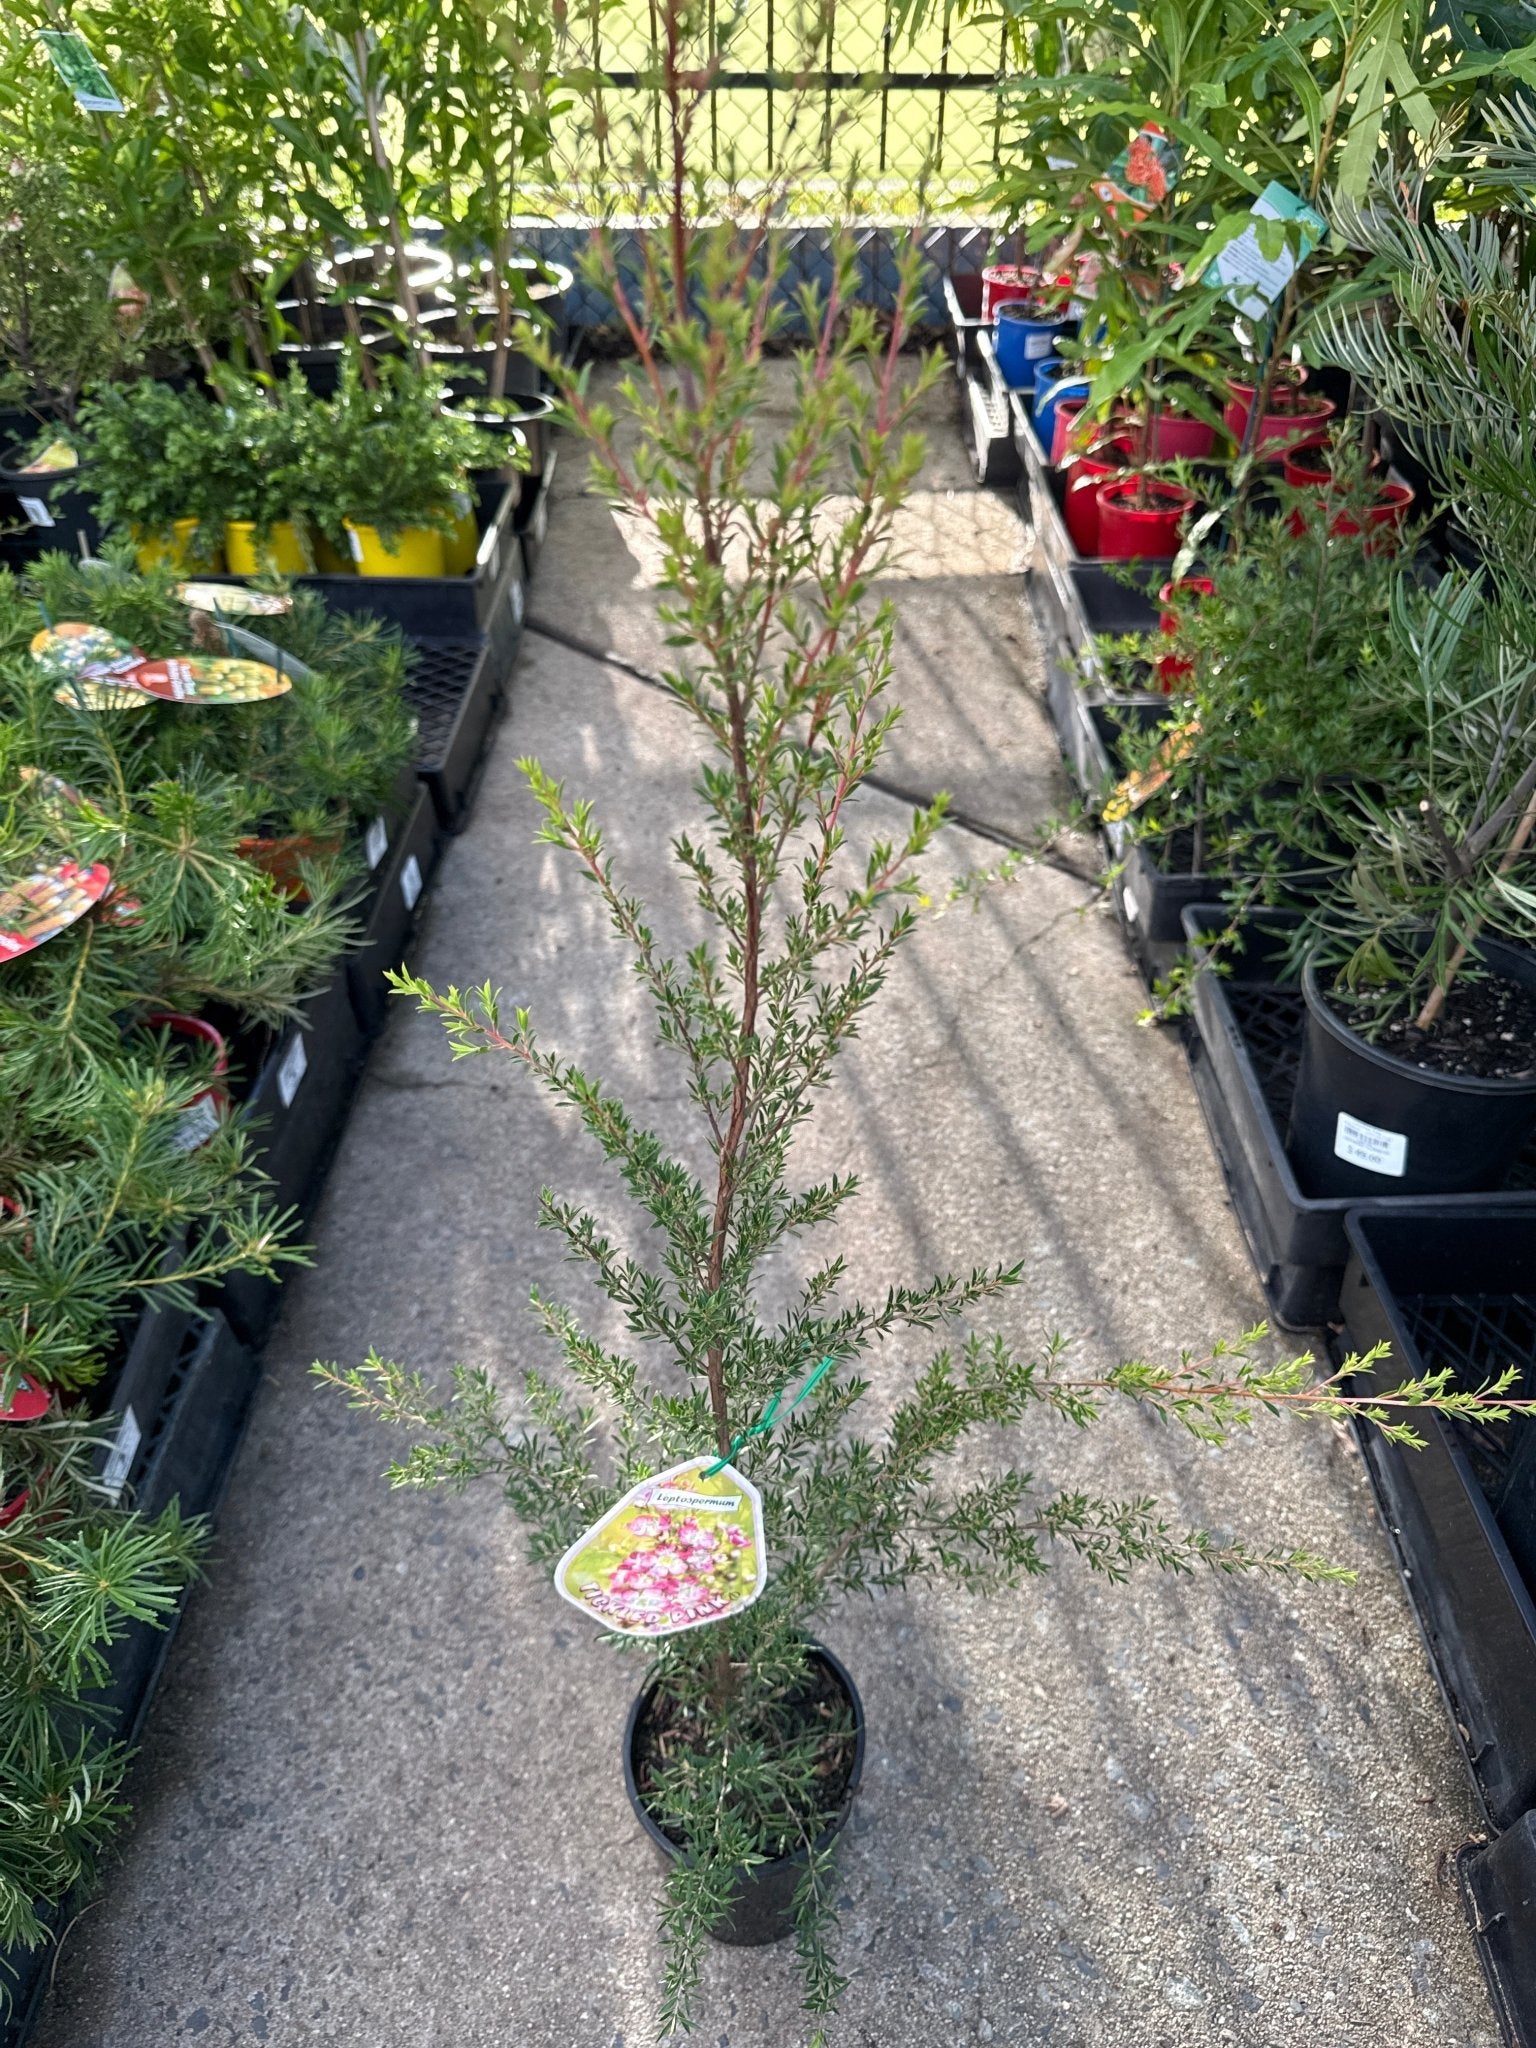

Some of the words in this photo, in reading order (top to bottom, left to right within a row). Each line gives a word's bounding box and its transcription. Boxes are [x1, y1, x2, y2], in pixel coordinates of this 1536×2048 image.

[656, 1492, 735, 1508] Leptospermum
[579, 1582, 659, 1624] TICKLED
[670, 1594, 729, 1624] PINK
